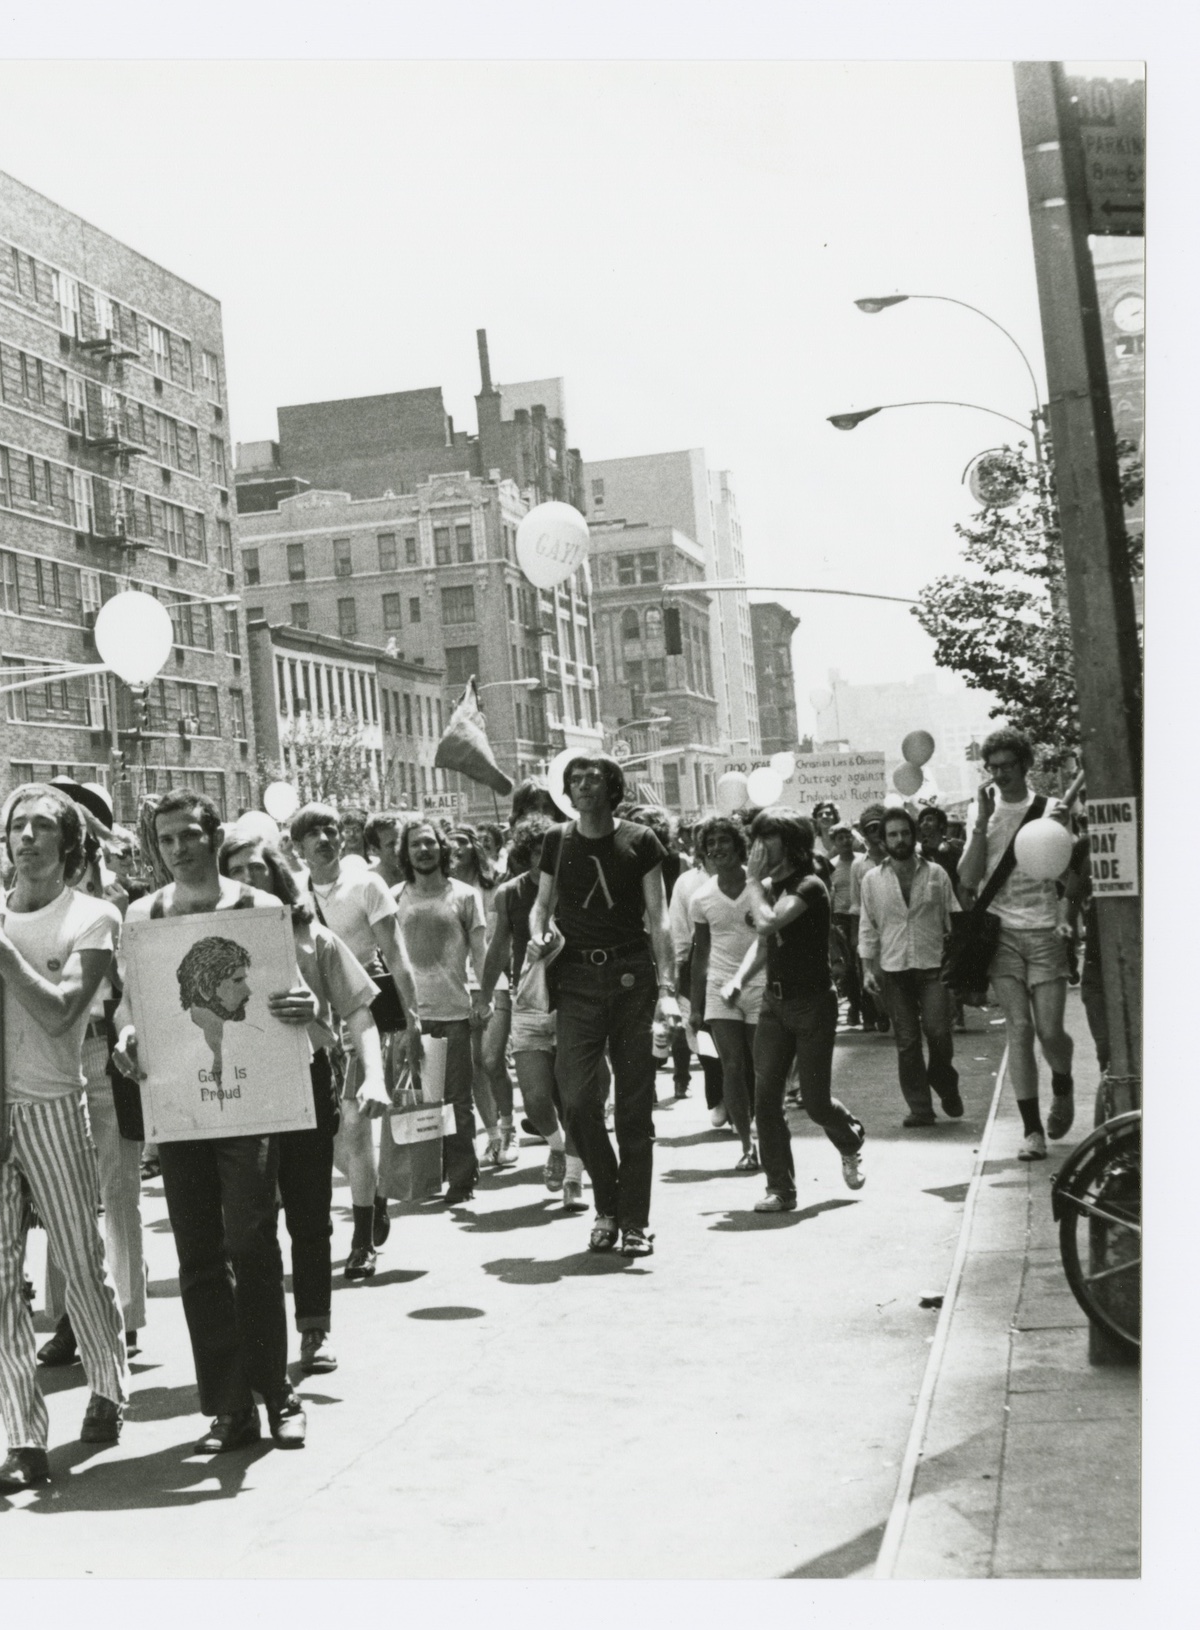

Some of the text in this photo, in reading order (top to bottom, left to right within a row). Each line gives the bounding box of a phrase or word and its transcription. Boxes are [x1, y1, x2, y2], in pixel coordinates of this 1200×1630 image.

[798, 772, 885, 787] Outrage against
[851, 787, 886, 803] Rights
[1088, 803, 1132, 824] RKING
[1091, 833, 1117, 854] DAY
[234, 1066, 247, 1080] Is
[200, 1085, 241, 1101] Proud
